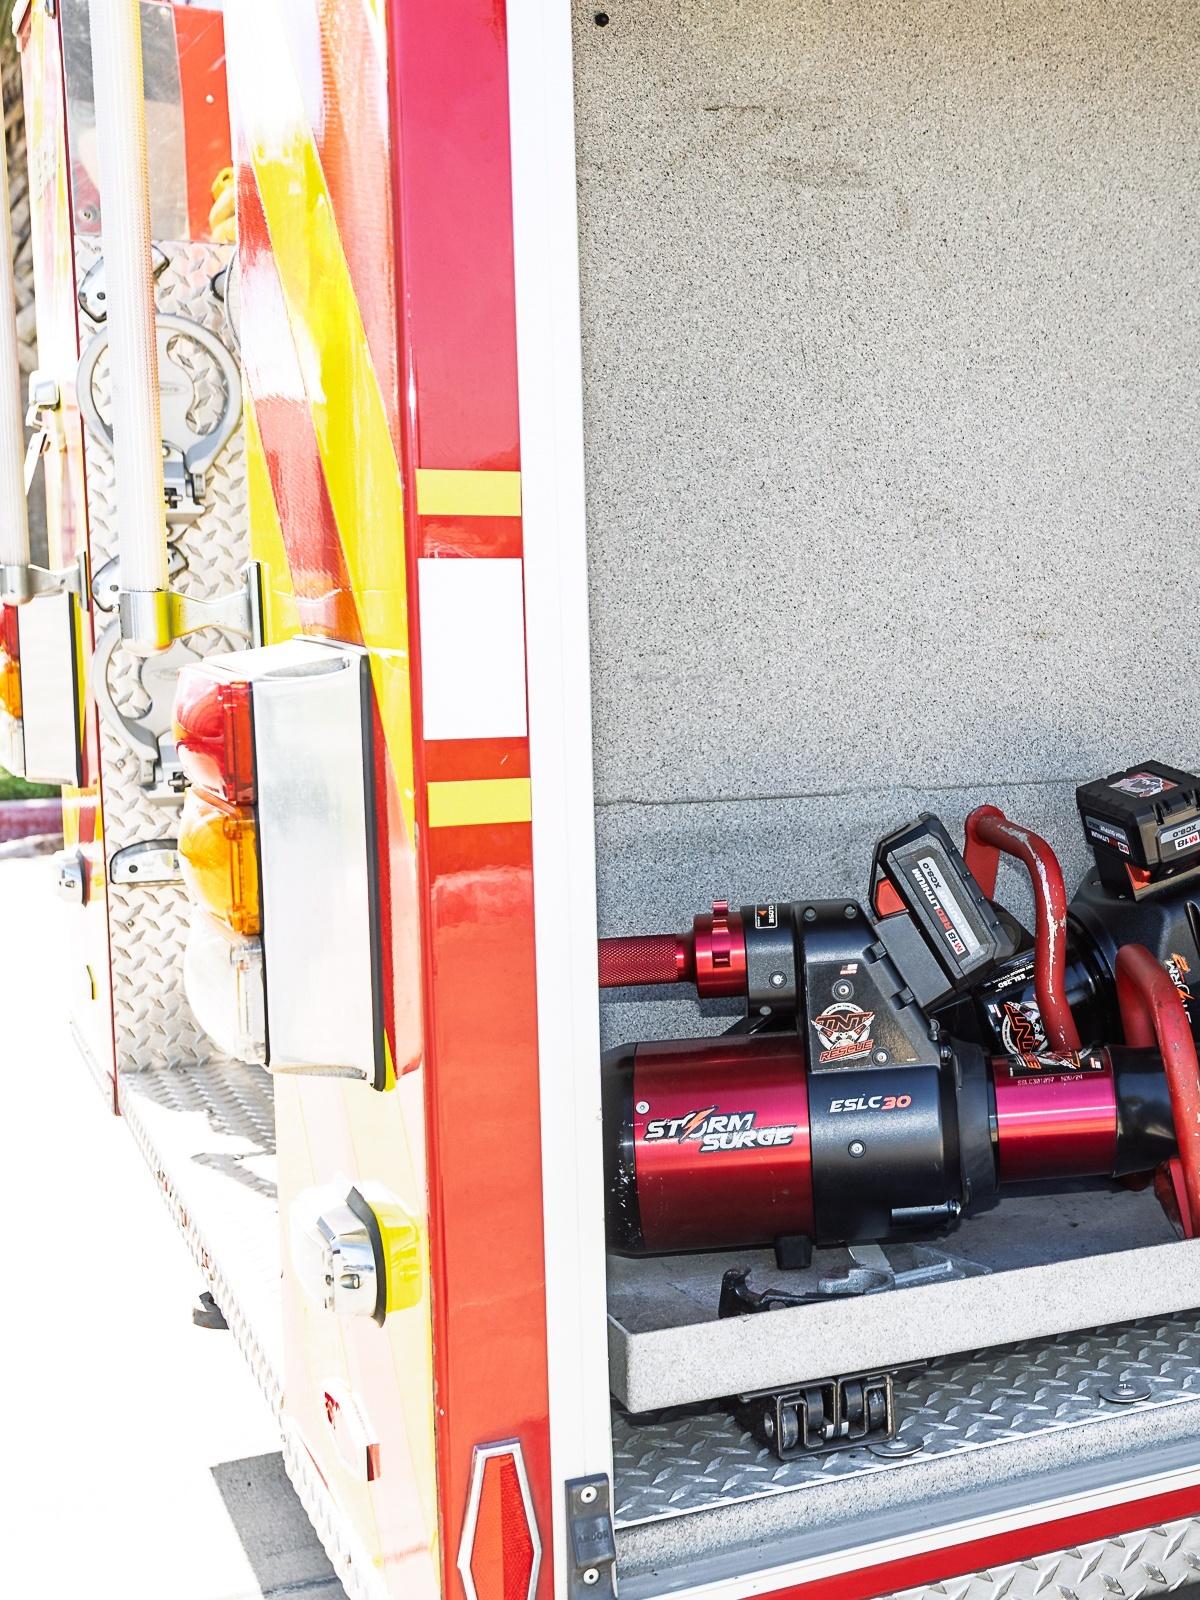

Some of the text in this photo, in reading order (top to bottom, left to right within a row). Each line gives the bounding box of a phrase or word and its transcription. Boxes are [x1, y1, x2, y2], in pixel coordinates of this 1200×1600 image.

[1172, 823, 1197, 838] XC8.0
[1176, 833, 1199, 850] M18
[922, 862, 941, 889] XC8.0
[912, 867, 964, 953] M18 REDLITHIUM
[815, 1011, 874, 1033] TNT
[819, 1039, 874, 1064] RESCUE
[829, 1095, 912, 1113] ESLC30
[645, 1104, 755, 1145] STORM
[699, 1124, 798, 1151] SURGE
